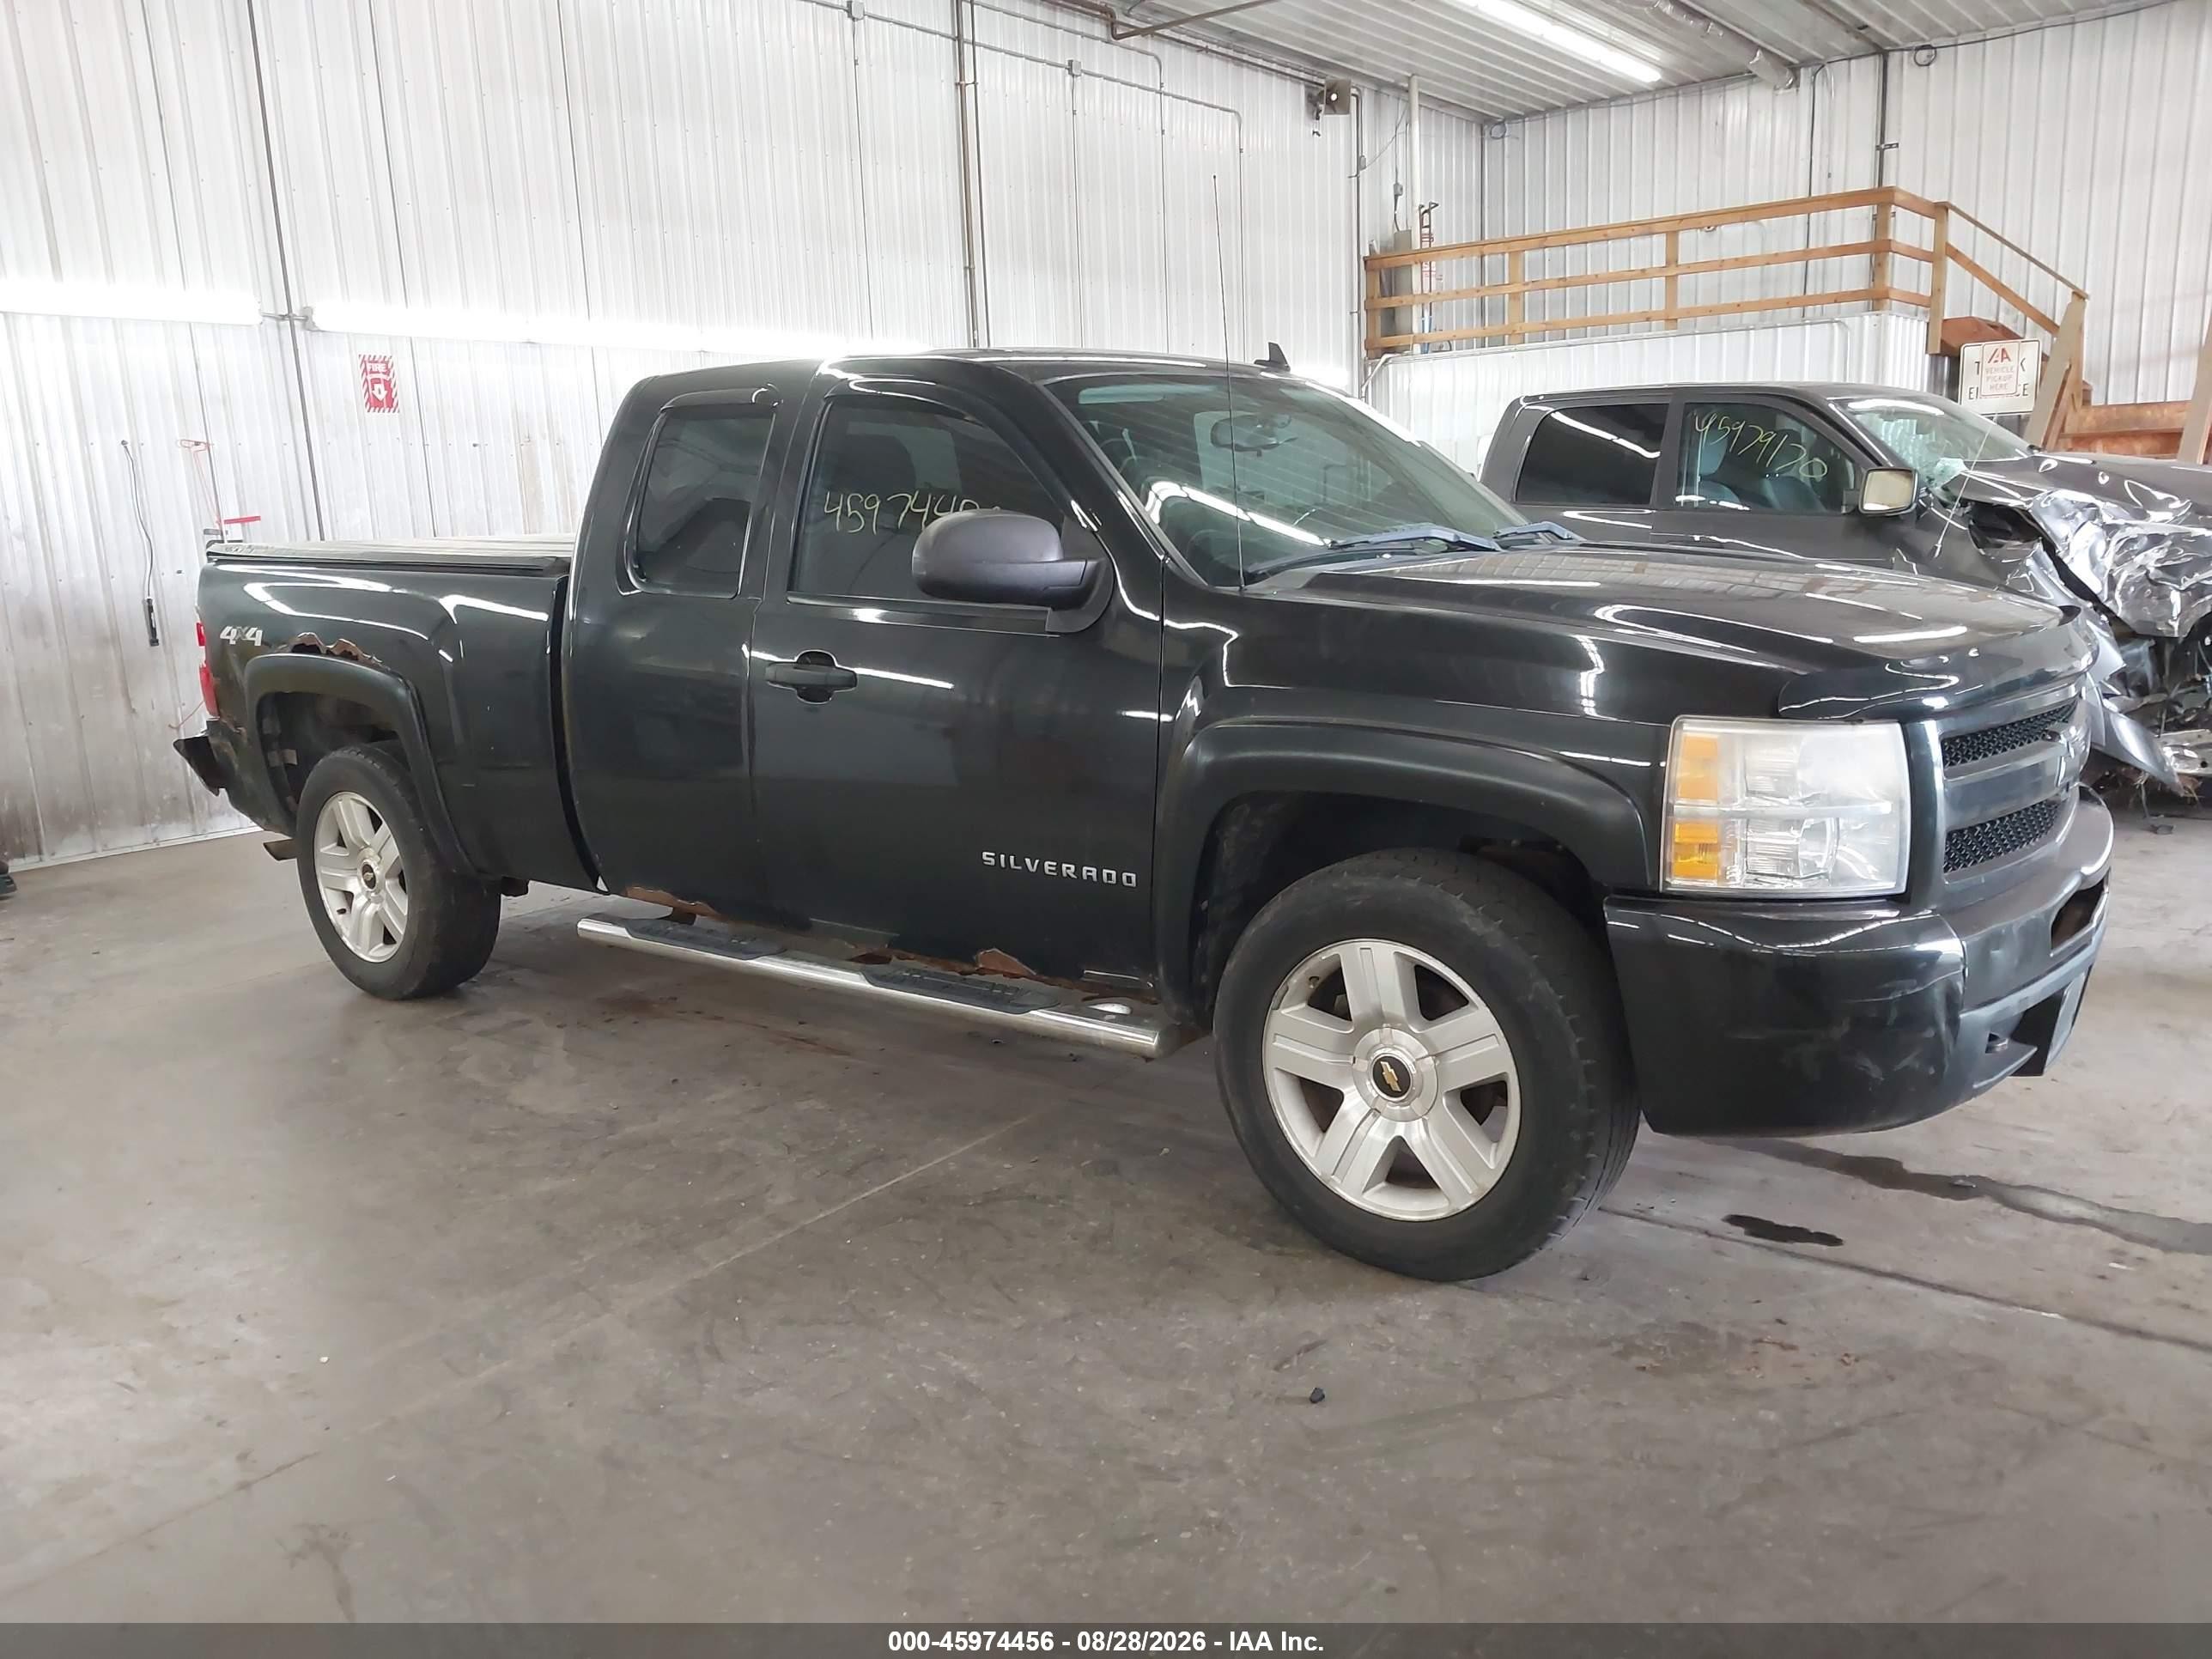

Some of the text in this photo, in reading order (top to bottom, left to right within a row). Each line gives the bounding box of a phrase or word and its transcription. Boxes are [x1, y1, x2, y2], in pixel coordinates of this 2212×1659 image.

[368, 362, 387, 373] FIRE
[1990, 383, 2008, 392] HERE
[981, 851, 1138, 888] SILVERADO
